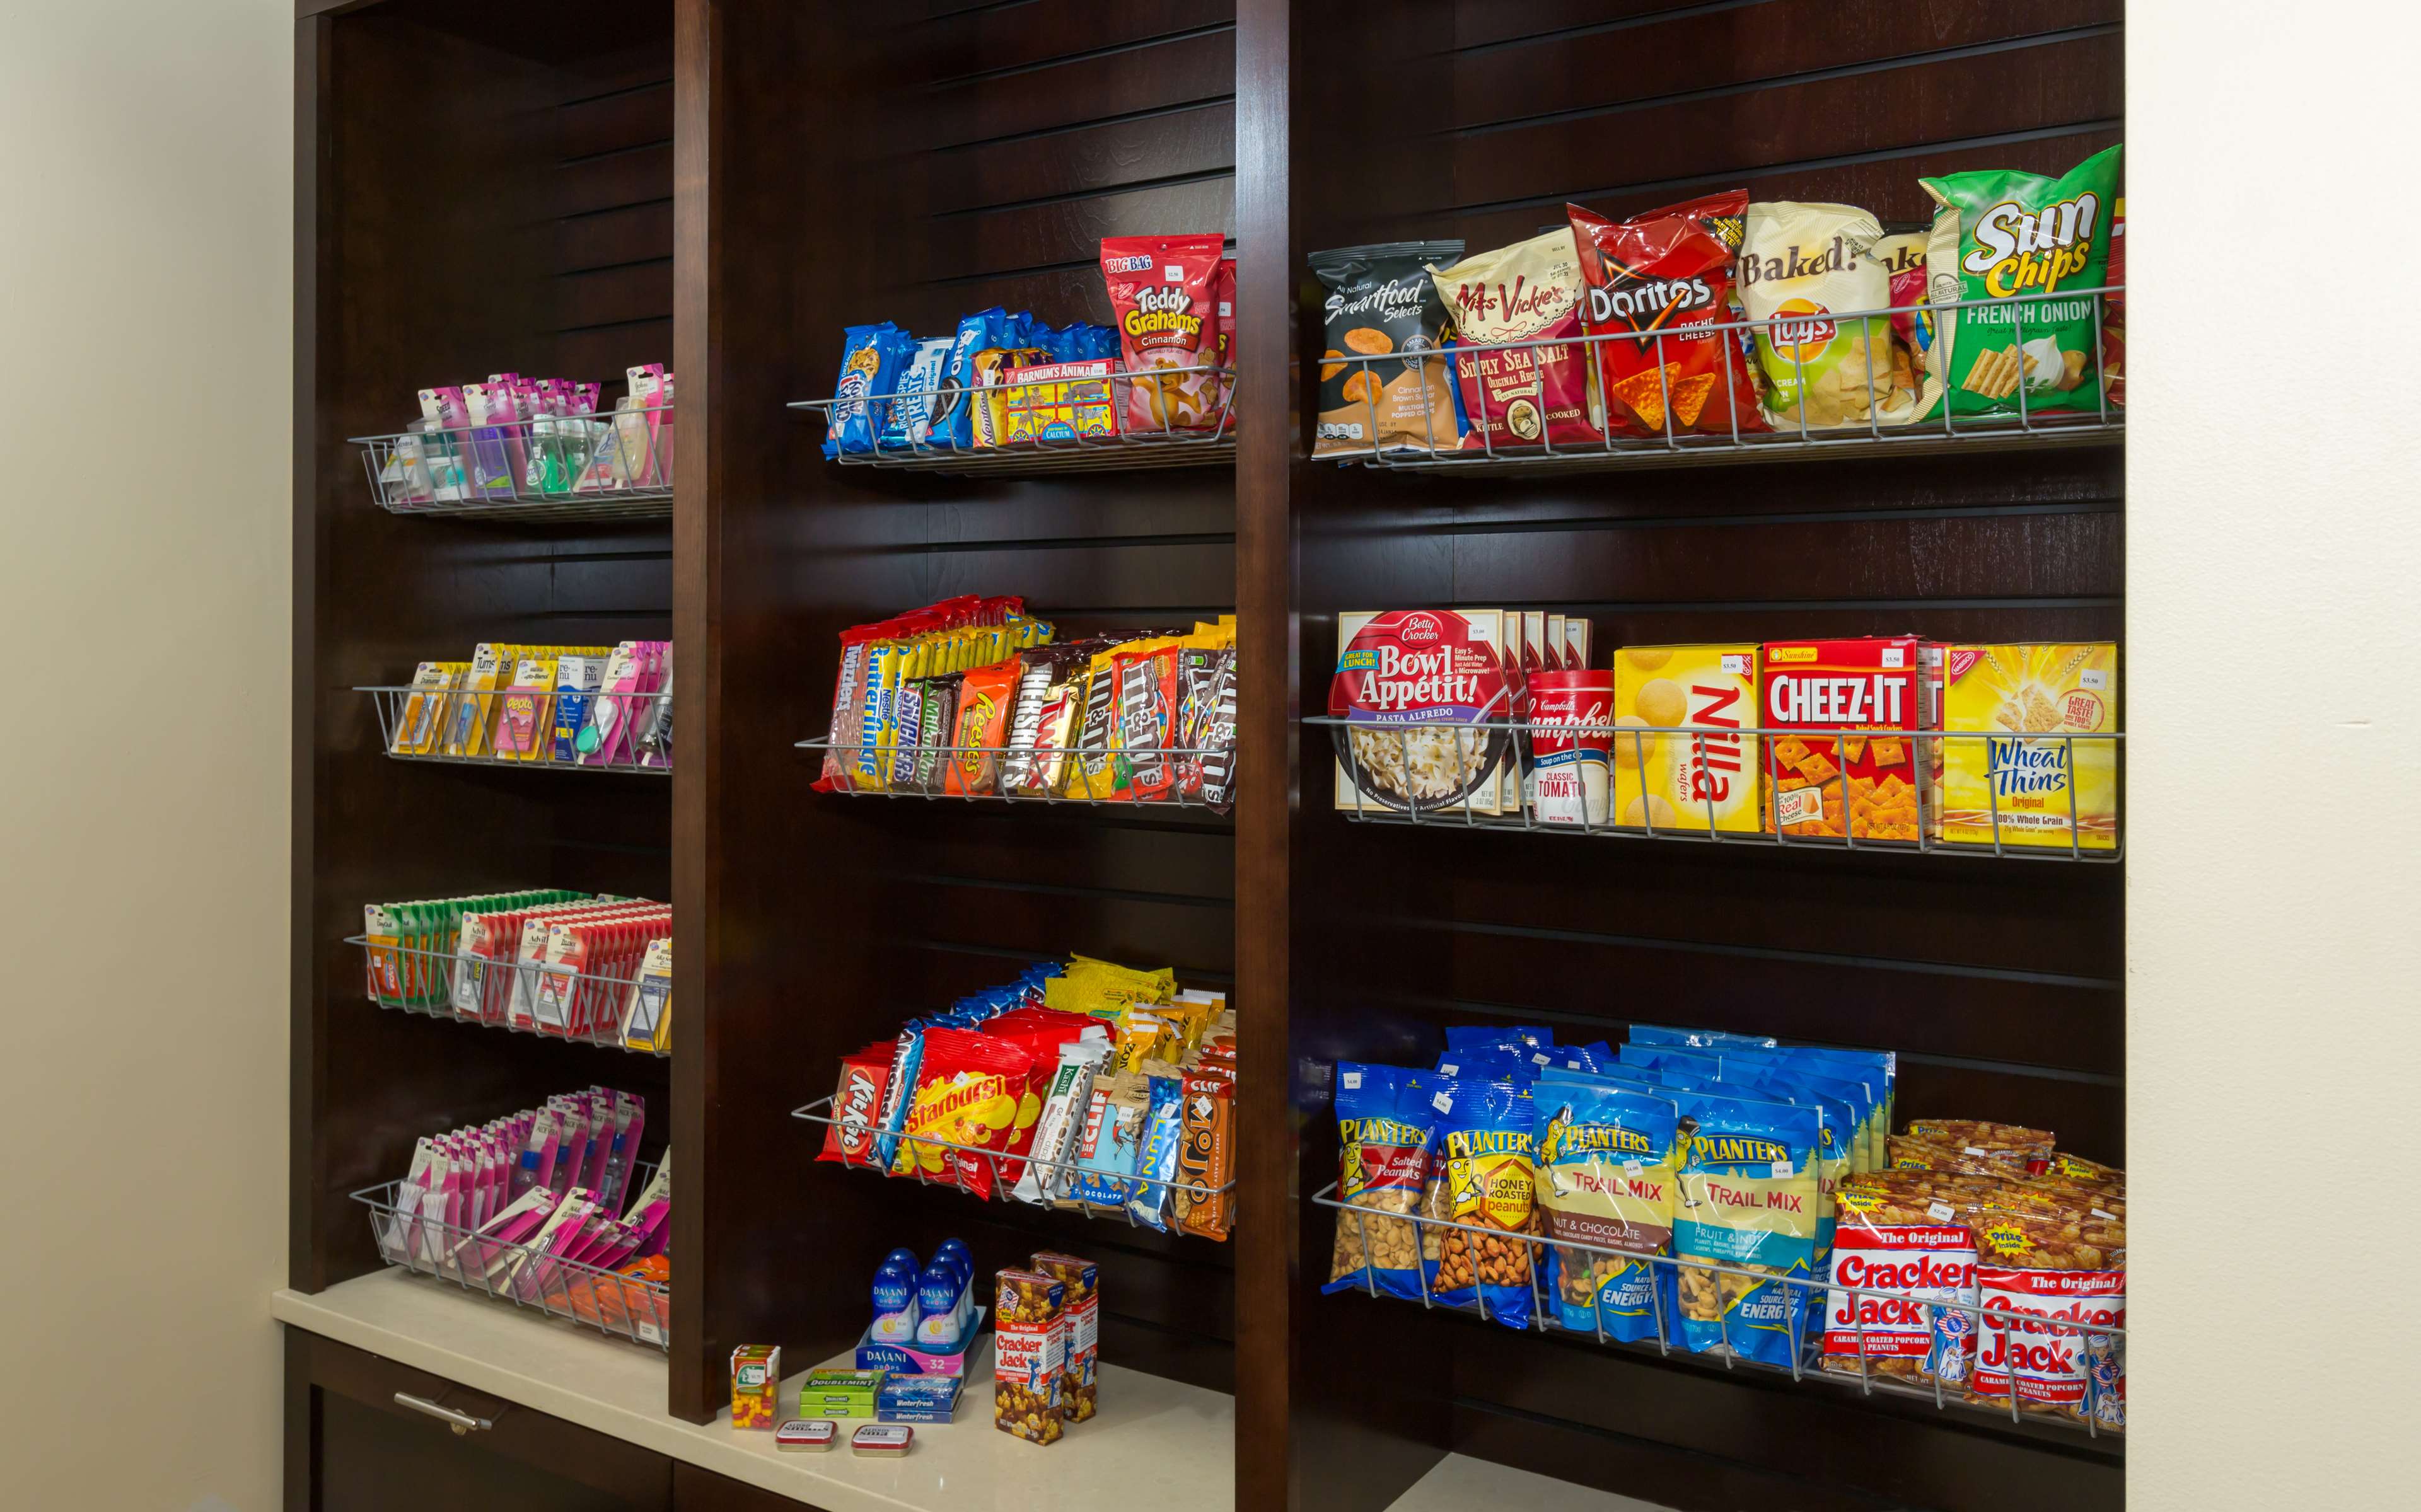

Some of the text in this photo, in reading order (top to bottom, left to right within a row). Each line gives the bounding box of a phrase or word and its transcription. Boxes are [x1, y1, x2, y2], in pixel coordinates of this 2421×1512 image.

[1964, 192, 2097, 272] Sun
[1106, 255, 1152, 274] BIG BAG
[1740, 236, 1857, 289] Baked!
[1986, 241, 2090, 298] Chips
[1337, 281, 1372, 294] All Natural
[1938, 285, 1967, 296] NATURAL
[1134, 286, 1191, 315] Teddy
[1325, 279, 1424, 326] Smartfood
[1498, 275, 1565, 323] Vickie's
[1589, 278, 1711, 323] Doritos
[1383, 304, 1423, 323] Selects
[2040, 299, 2092, 323] ONION
[1125, 309, 1202, 337] Grahams
[1773, 312, 1828, 347] Lay's
[1987, 326, 2007, 336] Great
[1141, 335, 1187, 347] Cinnamon
[1407, 338, 1425, 347] SMART
[841, 349, 856, 378] ORIGINAL
[1502, 343, 1569, 372] SEA SALT
[928, 360, 936, 386] Original
[1017, 367, 1060, 383] BARNUM'S
[1487, 374, 1519, 389] ORIGINAL
[1391, 410, 1416, 418] POPPED
[1546, 408, 1581, 421] COOKED
[1045, 430, 1071, 439] CALCIUM
[1409, 617, 1434, 630] Betty
[1402, 628, 1438, 642] Crocker
[1378, 645, 1454, 678] Bowl
[1474, 654, 1487, 662] Prep
[1783, 649, 1816, 660] Sunshine
[477, 657, 495, 670] Tums
[559, 663, 571, 672] re-
[584, 665, 598, 674] re-
[1344, 657, 1376, 668] LUNCH!
[1951, 652, 1975, 675] NABISCO
[559, 672, 570, 680] nu
[584, 672, 597, 681] nu
[1356, 671, 1478, 710] Appétit!
[1540, 700, 1576, 712] Campbell's
[1770, 674, 1907, 723] CHEEZ-IT
[2068, 695, 2096, 710] GREAT
[1376, 707, 1454, 722] PASTA ALFREDO
[2067, 705, 2093, 718] TASTE!
[893, 689, 922, 783] SNICKERS
[963, 691, 996, 775] Reese's
[1691, 684, 1741, 803] Nilla
[1540, 758, 1553, 766] Soup
[1560, 753, 1572, 761] the
[1990, 737, 2068, 771] Wheat
[1546, 772, 1574, 782] CLASSIC
[1679, 763, 1690, 802] wafers
[1983, 767, 2068, 796] Thins
[1366, 787, 1446, 811] No Preservatives Artificial
[1779, 795, 1802, 815] Real
[1784, 793, 1799, 804] 100%
[2012, 796, 2045, 809] Original
[2016, 814, 2064, 826] Whole Grain
[471, 926, 486, 937] Advil
[1057, 1067, 1075, 1094] Kashi
[1190, 1080, 1221, 1094] CLIF
[842, 1073, 876, 1148] Kit Kat
[907, 1074, 1006, 1133] Starburst
[618, 1108, 629, 1116] ALOE
[1084, 1091, 1107, 1143] CLIF
[535, 1125, 548, 1133] ALOE
[1340, 1119, 1427, 1146] PLANTERS
[1447, 1130, 1533, 1158] PLANTERS
[1566, 1125, 1651, 1153] PLANTERS
[1694, 1136, 1788, 1162] PLANTERS
[1136, 1119, 1166, 1196] LUNA
[1391, 1157, 1423, 1169] Salted
[1377, 1164, 1420, 1180] Peanuts
[1490, 1178, 1533, 1191] HONEY
[1572, 1171, 1663, 1203] TRAIL MIX
[1489, 1189, 1531, 1201] ROASTED
[1707, 1182, 1803, 1213] TRAIL MIX
[1488, 1199, 1531, 1214] peanuts
[1934, 1208, 1948, 1216] $2.00
[1553, 1217, 1640, 1240] NUT & CHOCOLATE
[1695, 1226, 1735, 1242] FRUIT &
[1880, 1231, 1964, 1246] The Original
[1991, 1231, 2024, 1244] Prize
[1998, 1241, 2021, 1249] Inside
[1837, 1255, 1977, 1290] Cracker
[1620, 1283, 1649, 1291] SOURCE
[2031, 1276, 2116, 1291] The Original
[873, 1286, 907, 1297] DASANI
[920, 1287, 954, 1298] DASANI
[1602, 1289, 1654, 1307] ENERGY!
[1835, 1291, 1924, 1325] Jack
[996, 1335, 1042, 1353] Cracker
[1866, 1336, 1930, 1344] COATED POPCORN
[1867, 1343, 1899, 1351] PEANUTS
[867, 1351, 907, 1363] DASANI
[1000, 1351, 1028, 1368] Jack
[1981, 1332, 2076, 1374] Jack
[929, 1359, 945, 1370] 32
[1906, 1374, 1917, 1382] NET
[2016, 1379, 2045, 1390] COATED
[2018, 1387, 2052, 1398] PEANUTS
[897, 1399, 934, 1407] Winterfresh
